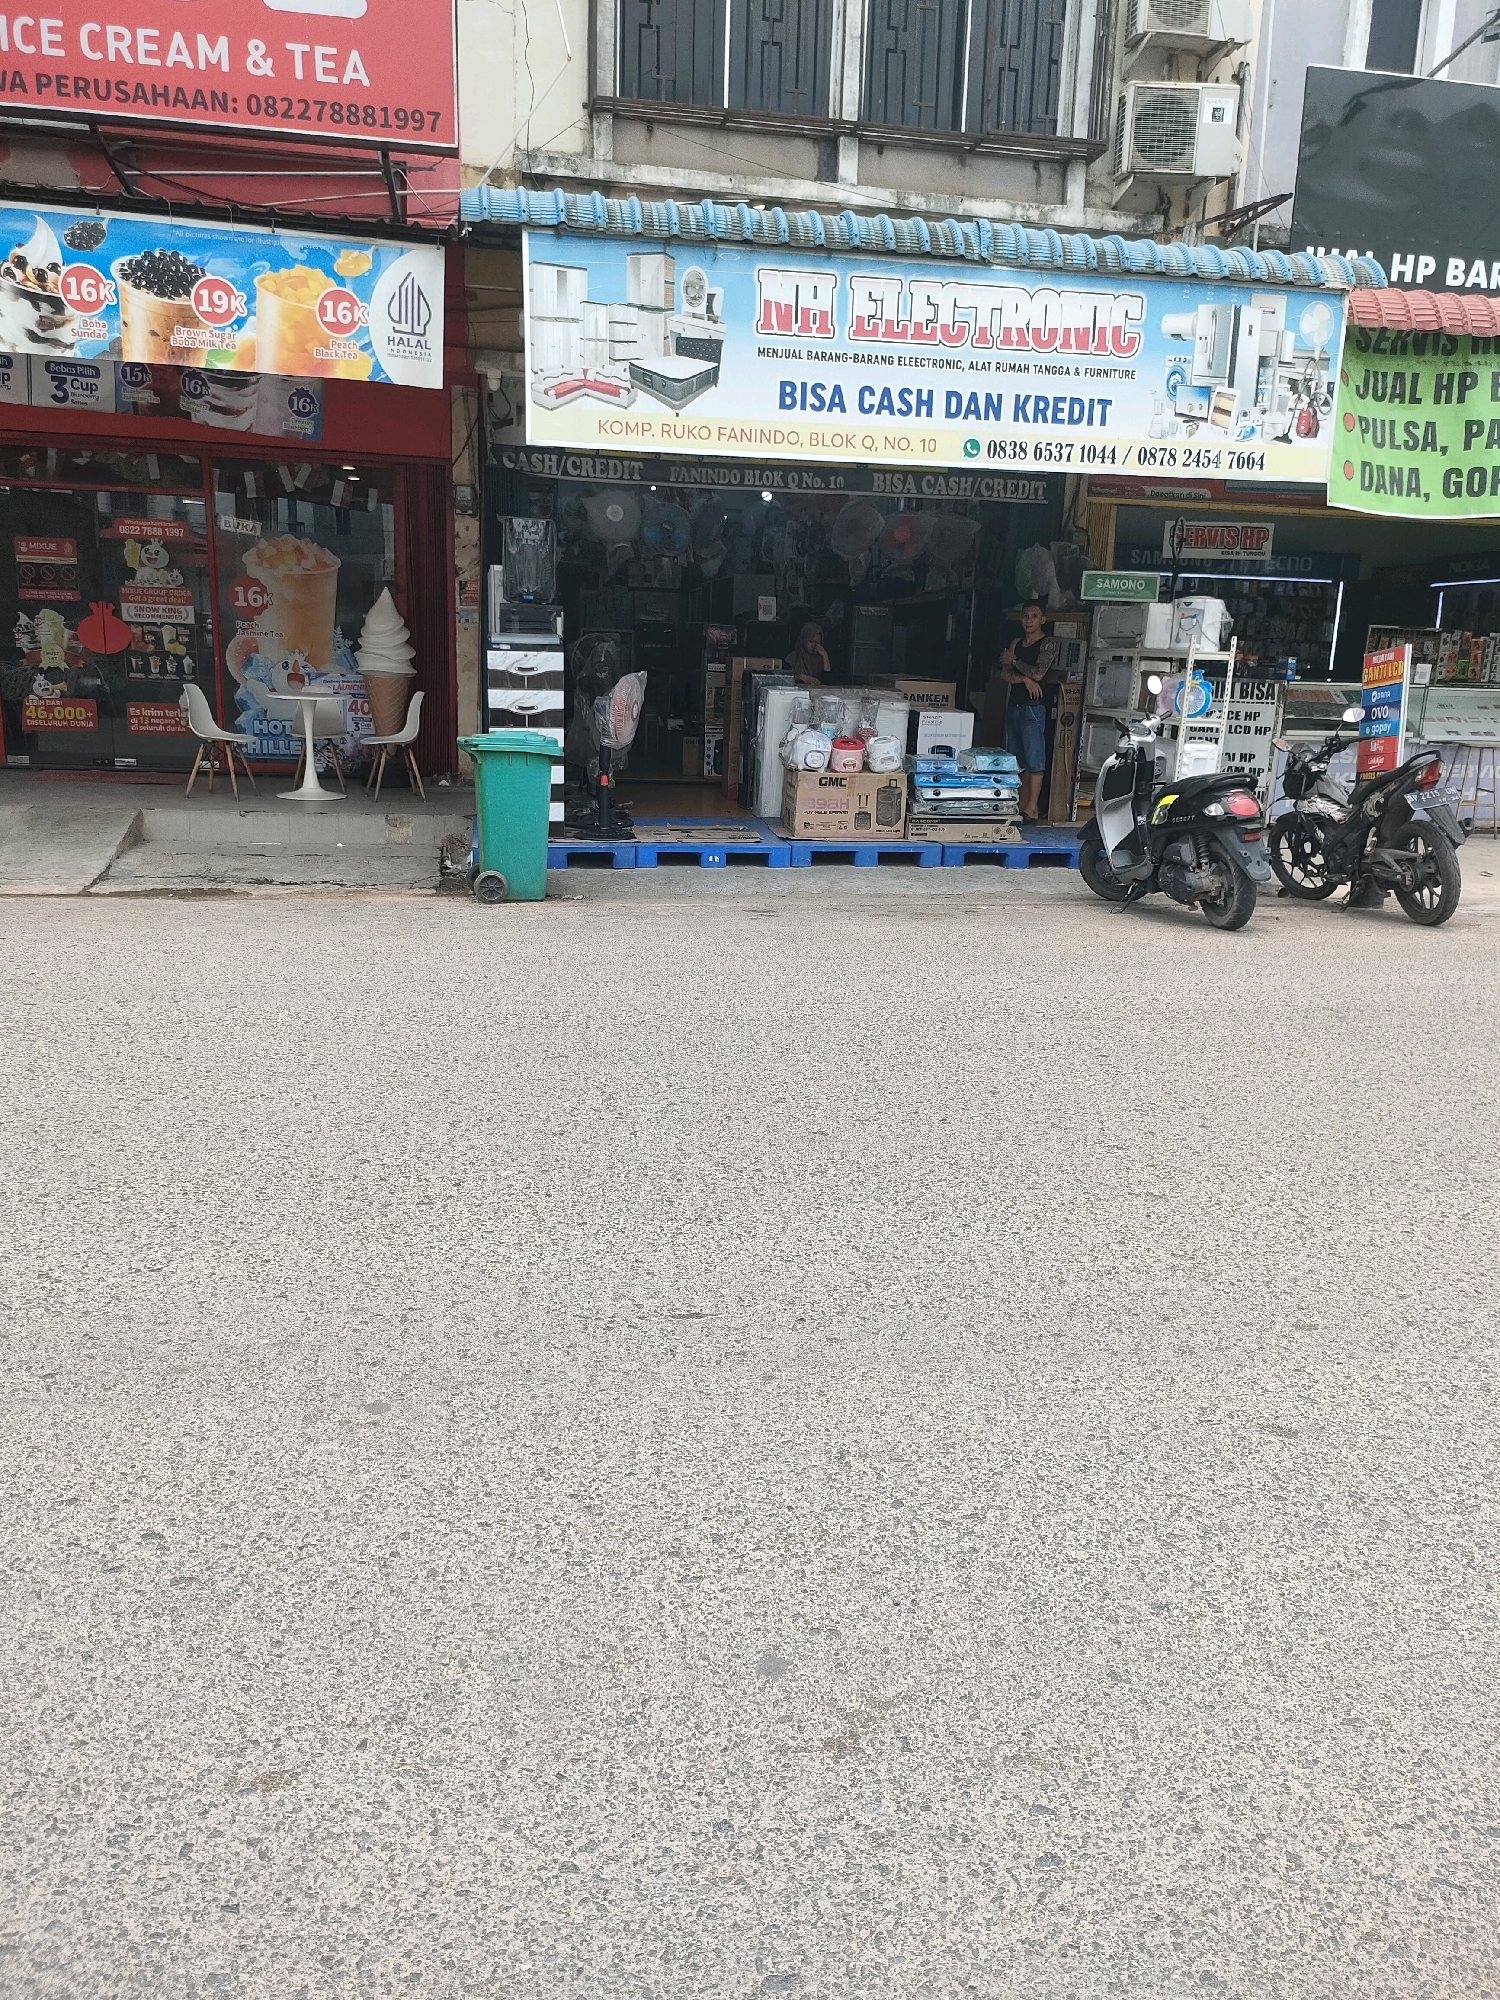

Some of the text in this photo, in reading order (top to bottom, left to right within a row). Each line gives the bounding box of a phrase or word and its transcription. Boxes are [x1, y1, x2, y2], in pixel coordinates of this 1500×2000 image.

[79, 22, 230, 73] CREAM
[246, 38, 276, 78] &
[285, 42, 370, 87] TEA
[35, 72, 238, 114] PERUSAHAAN:
[246, 93, 442, 133] 082278881997
[1390, 252, 1436, 284] HP
[66, 277, 116, 303] 16K
[199, 288, 245, 315] 19K
[323, 300, 368, 324] 16K
[849, 276, 1143, 359] ELECTRONIC
[82, 318, 107, 330] Boba
[71, 328, 108, 340] Sundae
[175, 326, 237, 343] Brown Sugar
[171, 336, 237, 350] Boba Milk Tea
[331, 340, 358, 350] Peach
[387, 335, 432, 350] HALAL
[315, 349, 358, 359] Black Tea
[386, 348, 432, 358] INDONESIA
[51, 363, 96, 376] Bebas Pilih
[758, 347, 803, 360] MENJUAL
[806, 350, 894, 366] BARANG-BARANG
[968, 360, 992, 372] ALAT
[995, 362, 1030, 374] RUMAH
[1033, 364, 1071, 377] TANGGA
[1074, 367, 1081, 377] &
[1084, 367, 1137, 380] FURNITURE
[51, 376, 98, 404] 3 Cup
[1356, 369, 1422, 404] JUAL
[1433, 372, 1478, 405] HP
[779, 380, 1113, 427] BISA CASH DAN KREDIT
[598, 419, 937, 453] KOMP. RUKO FANINDO, BLOK Q, NO. 10
[1358, 415, 1449, 456] PULSA,
[987, 439, 1265, 471] 0838 6537 1044 / 0878 2454 7664
[502, 452, 643, 481] CASH/CREDIT
[669, 465, 740, 485] FANINDO
[744, 470, 783, 487] BLOK
[788, 471, 799, 489] Q
[802, 473, 825, 489] No.
[829, 475, 845, 489] 10
[872, 472, 917, 495] BISA
[922, 475, 1047, 500] CASH/CREDIT
[1360, 460, 1431, 502] DANA,
[119, 526, 141, 535] 0822
[164, 528, 184, 537] 1997
[223, 517, 260, 534] BUKA
[1241, 526, 1270, 550] HP
[29, 542, 57, 551] MIXUE
[1096, 578, 1146, 590] SAMONO
[234, 586, 273, 607] 16K
[134, 606, 159, 614] SNOW
[236, 621, 259, 629] Peach
[236, 629, 269, 637] Jasmine
[1363, 661, 1404, 682] GANTI LCD
[1240, 682, 1275, 700] BISA
[142, 708, 164, 716] krim
[1244, 711, 1260, 721] HP
[1371, 705, 1389, 720] OVO
[1228, 724, 1271, 736] LCD HP
[1371, 722, 1391, 735] gopay
[1240, 753, 1256, 763] HP
[1249, 767, 1265, 777] HP
[819, 777, 847, 788] GMC
